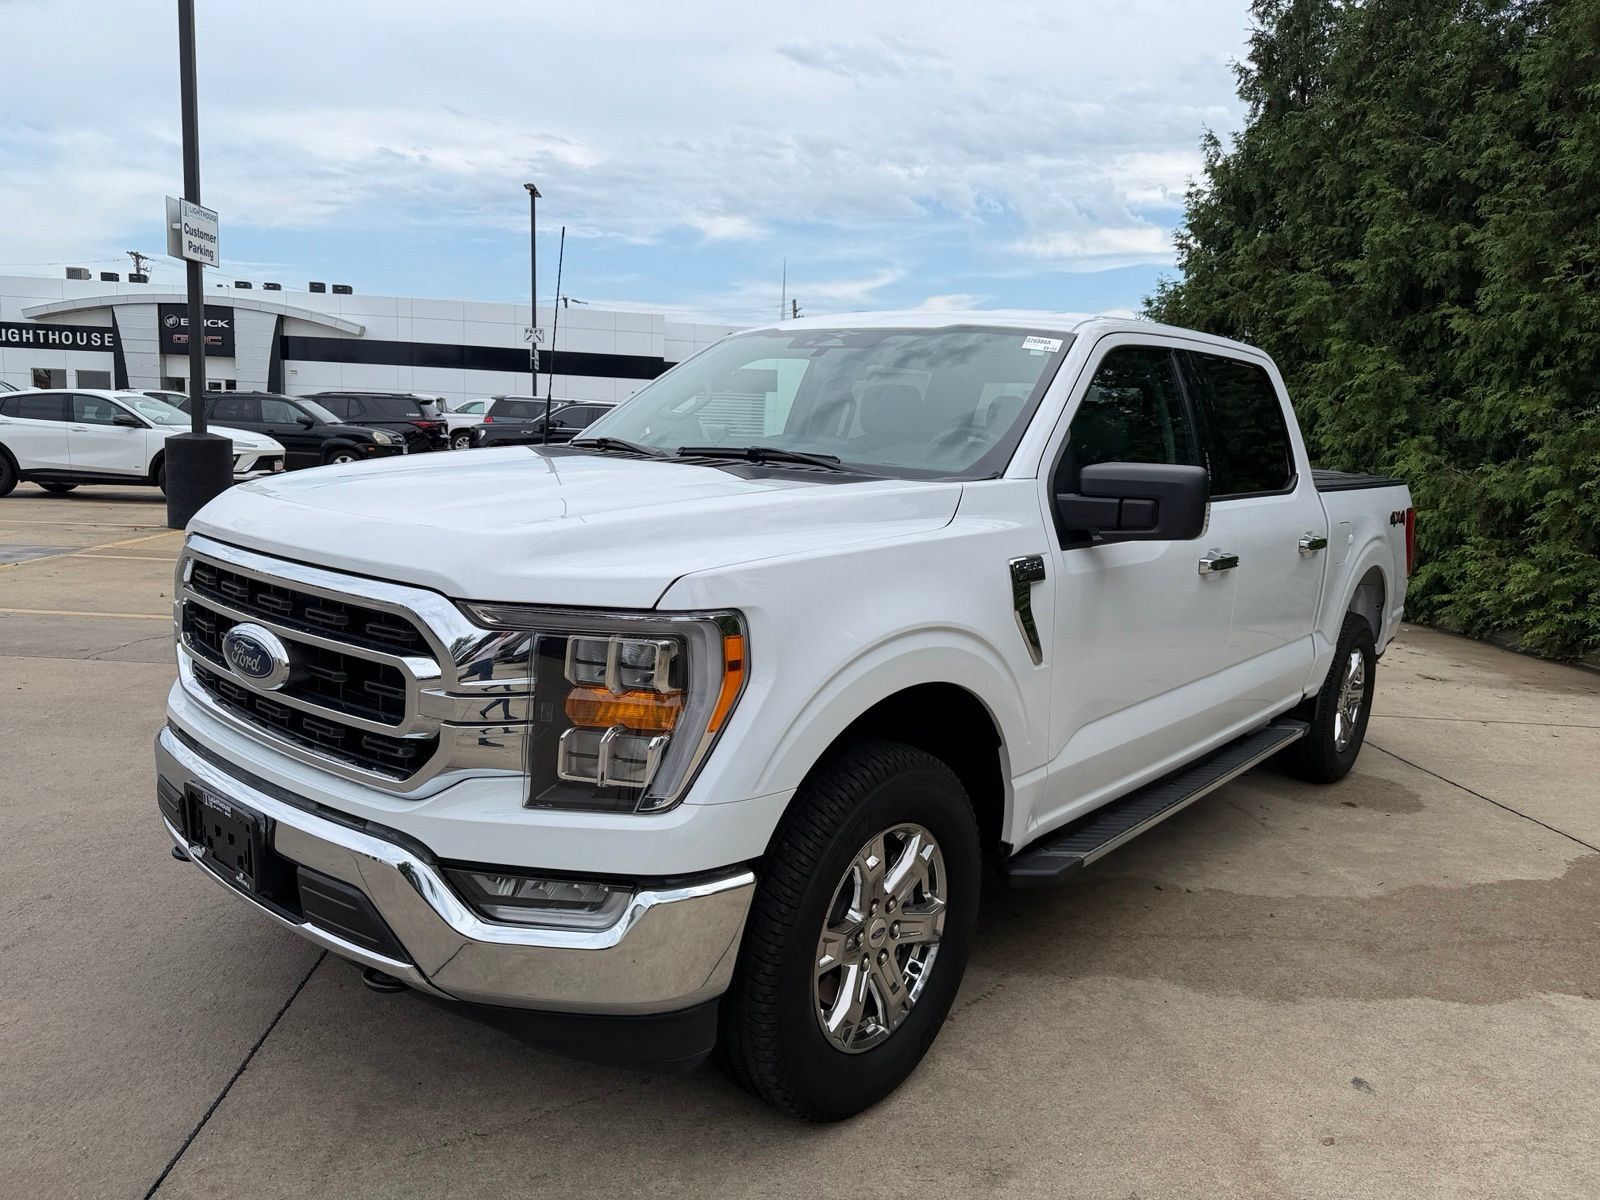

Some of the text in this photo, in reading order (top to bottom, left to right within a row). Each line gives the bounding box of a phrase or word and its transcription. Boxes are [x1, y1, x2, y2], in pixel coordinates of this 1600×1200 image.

[184, 222, 217, 244] Customer
[188, 240, 214, 261] Parking
[180, 317, 230, 328] BICK
[0, 328, 114, 346] IGHTHOUSE
[172, 334, 222, 346] GC
[231, 640, 262, 672] Ford
